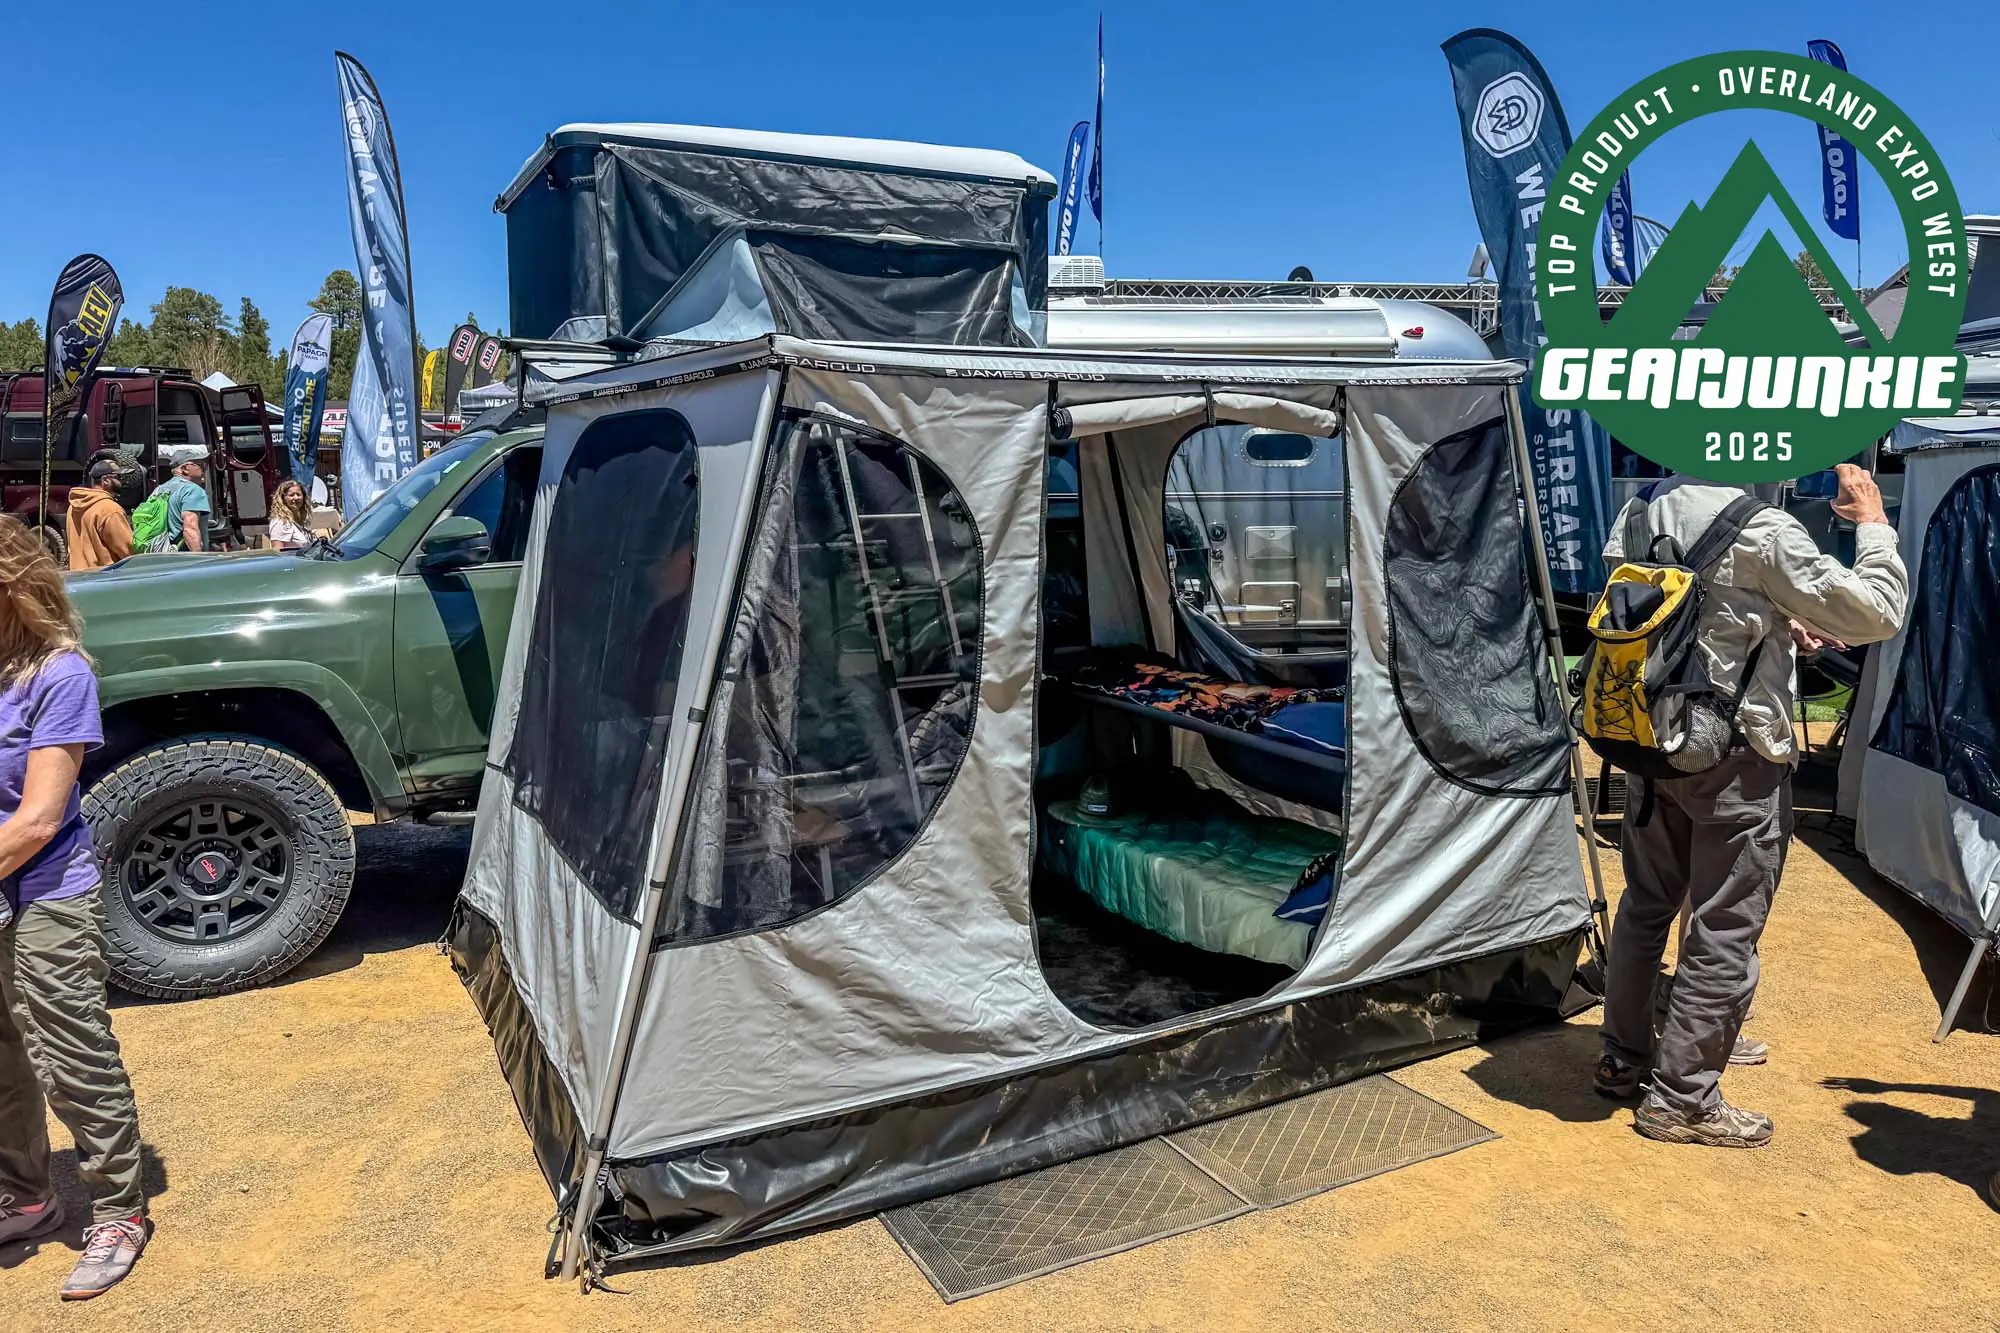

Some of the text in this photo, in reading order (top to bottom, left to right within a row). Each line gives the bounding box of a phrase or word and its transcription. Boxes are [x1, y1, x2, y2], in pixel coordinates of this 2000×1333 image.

[1826, 147, 1848, 220] TOYO
[1611, 213, 1626, 269] TOYO
[80, 288, 109, 337] AEV
[297, 345, 328, 357] PAPAGO
[456, 333, 471, 357] ARB
[482, 344, 496, 366] ARB
[660, 369, 715, 386] JAMES BAROUD
[747, 355, 876, 374] JAMES BAROUD
[961, 370, 1105, 381] JAMES BAROUD
[291, 387, 305, 452] BUILT TO
[299, 377, 317, 465] ADVENTURE
[1533, 433, 1561, 571] SUPERSTORE
